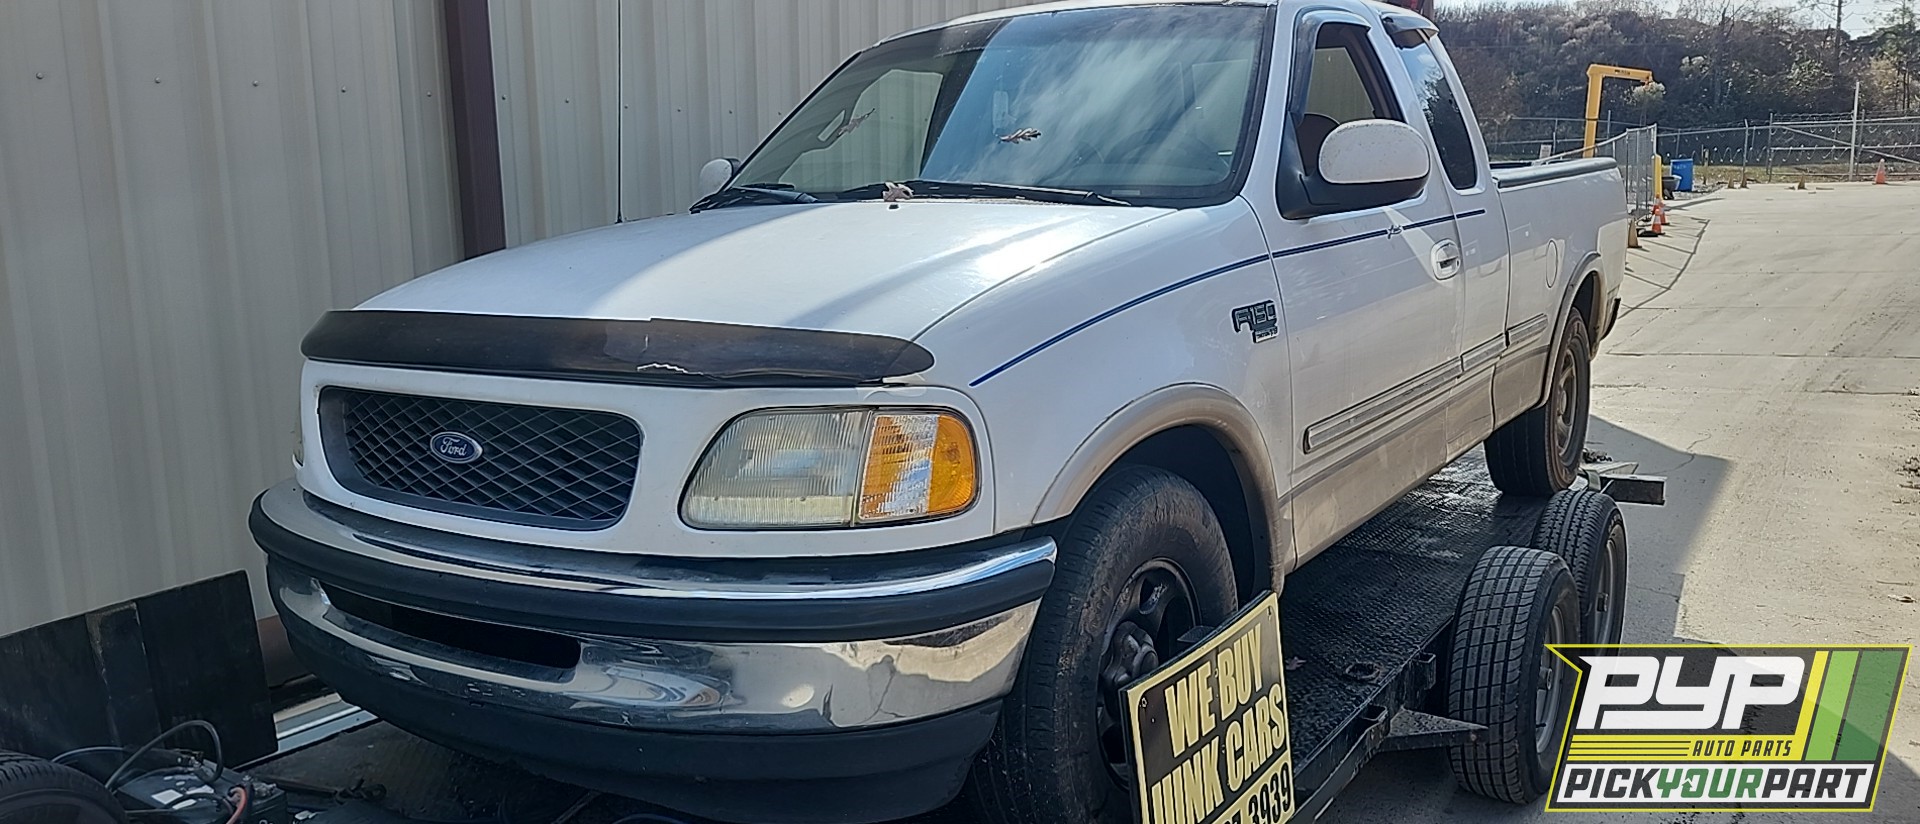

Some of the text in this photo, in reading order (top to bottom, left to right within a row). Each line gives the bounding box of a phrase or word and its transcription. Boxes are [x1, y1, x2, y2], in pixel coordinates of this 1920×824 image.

[440, 436, 468, 456] Ford
[1164, 622, 1263, 758] WE BUY
[1225, 683, 1285, 792] CARS
